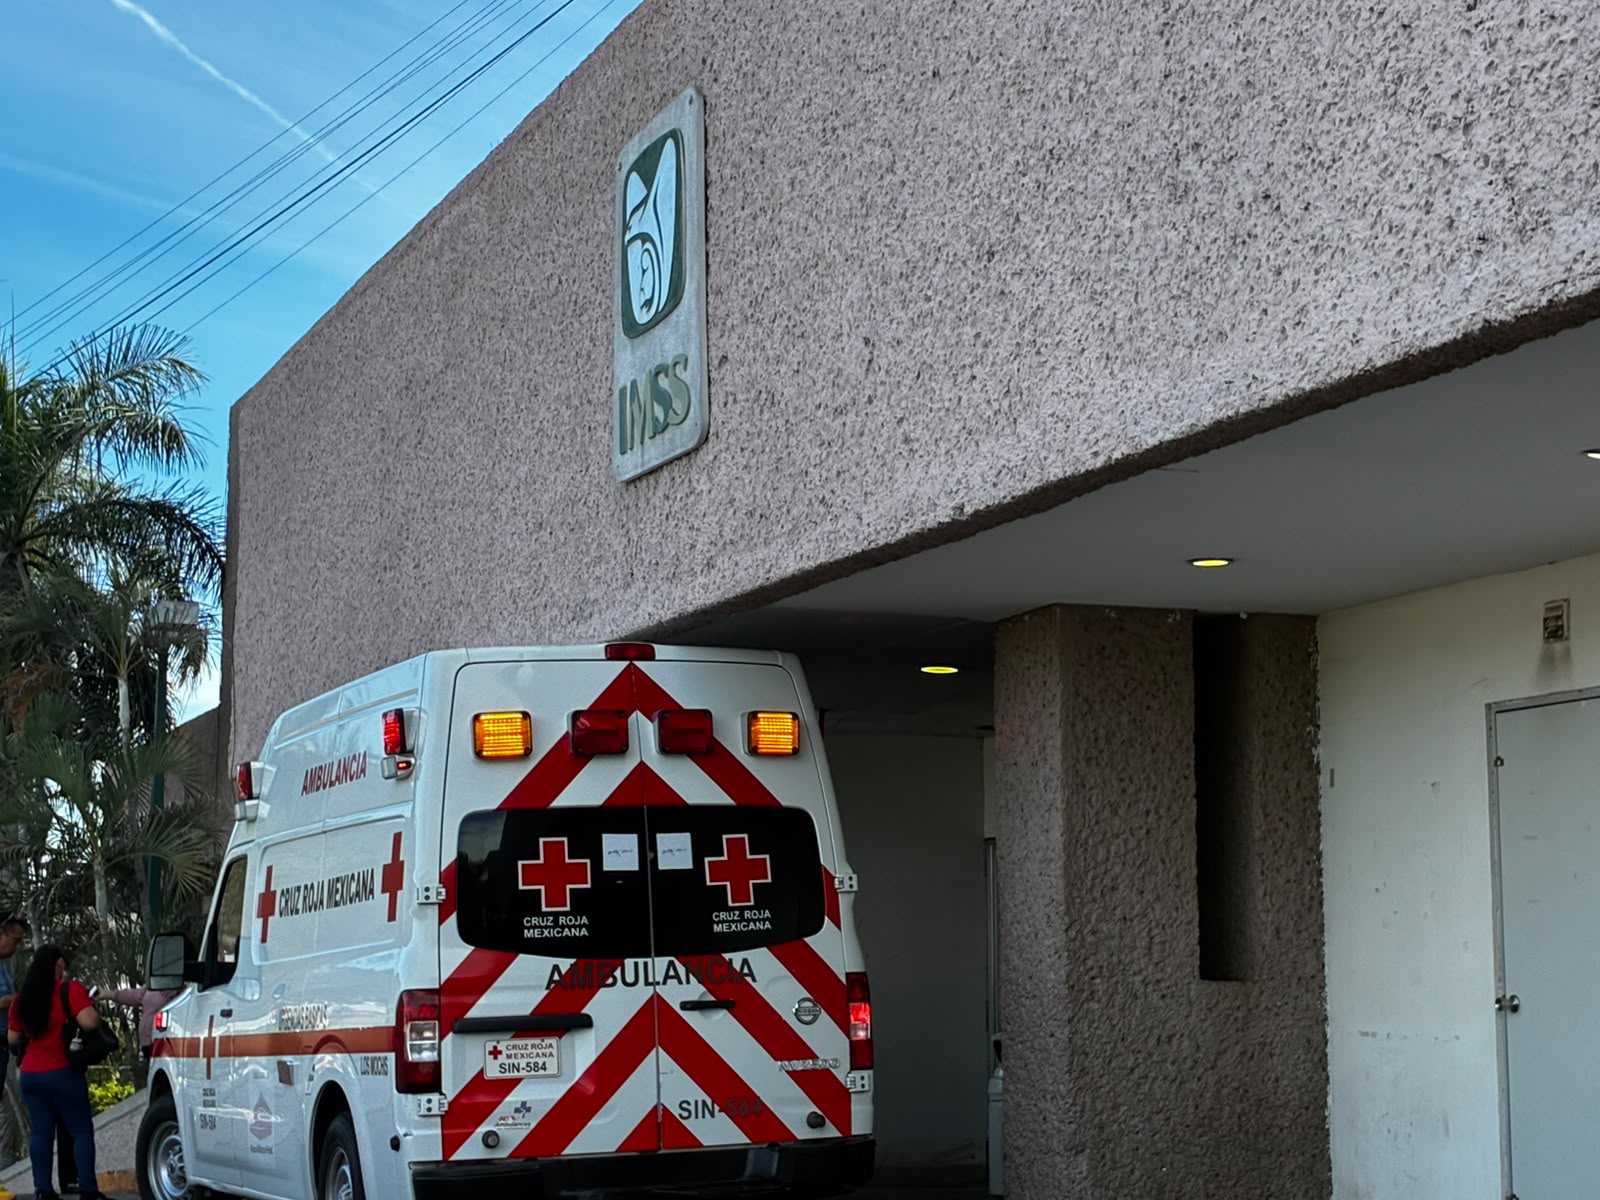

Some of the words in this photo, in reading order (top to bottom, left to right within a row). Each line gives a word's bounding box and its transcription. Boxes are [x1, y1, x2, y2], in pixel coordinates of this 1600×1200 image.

[618, 353, 691, 456] IMSS
[301, 750, 367, 797] AMBULANCIA
[279, 885, 301, 918] CRUZ
[302, 879, 325, 915] ROJA
[326, 867, 375, 910] MEXICANA
[523, 916, 554, 926] CRUZ
[558, 915, 589, 925] ROJA
[713, 911, 740, 921] CRUZ
[744, 909, 771, 919] ROJA
[713, 920, 772, 932] MEXICANA
[523, 927, 589, 938] MEXICANA
[545, 957, 758, 991] AMBULANCIA
[530, 1042, 554, 1050] ROJA
[505, 1051, 555, 1060] MEXICANA
[498, 1061, 547, 1074] SIN-584
